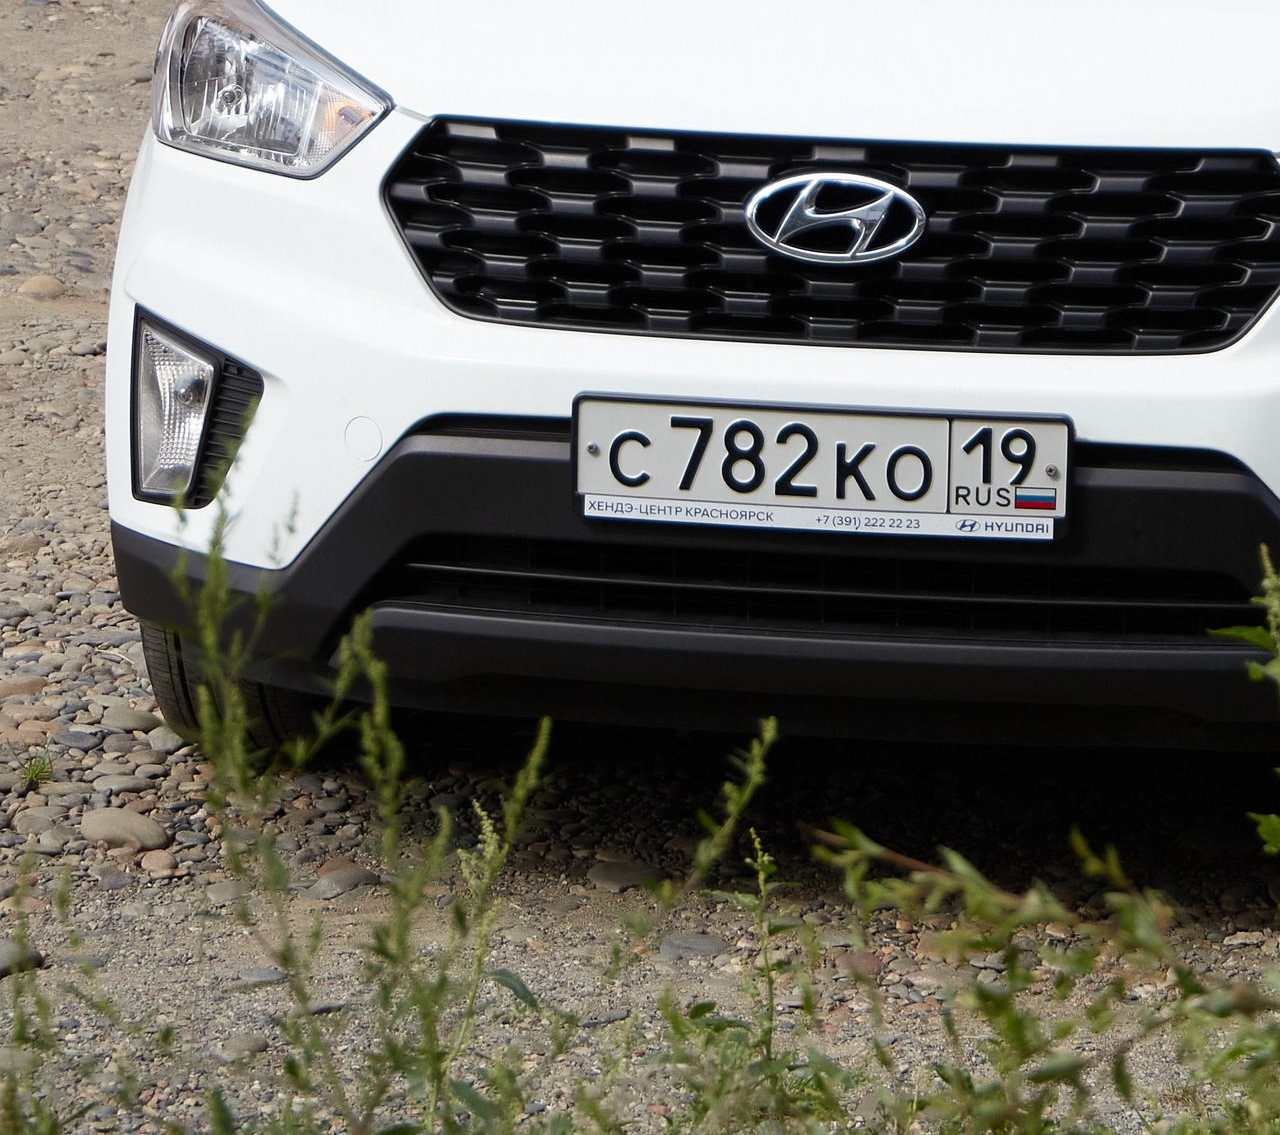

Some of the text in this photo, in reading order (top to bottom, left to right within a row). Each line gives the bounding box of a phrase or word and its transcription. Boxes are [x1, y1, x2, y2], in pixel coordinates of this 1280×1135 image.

[961, 426, 1038, 486] 19
[954, 485, 1011, 508] RUS
[588, 500, 774, 522] ХЕНДЭ-ЦЕНТР КРАСНОЯРСК
[832, 516, 861, 530] (391)
[864, 517, 886, 528] 222
[888, 518, 904, 528] 22
[906, 518, 920, 529] 23
[984, 521, 1050, 534] HYUNDAI
